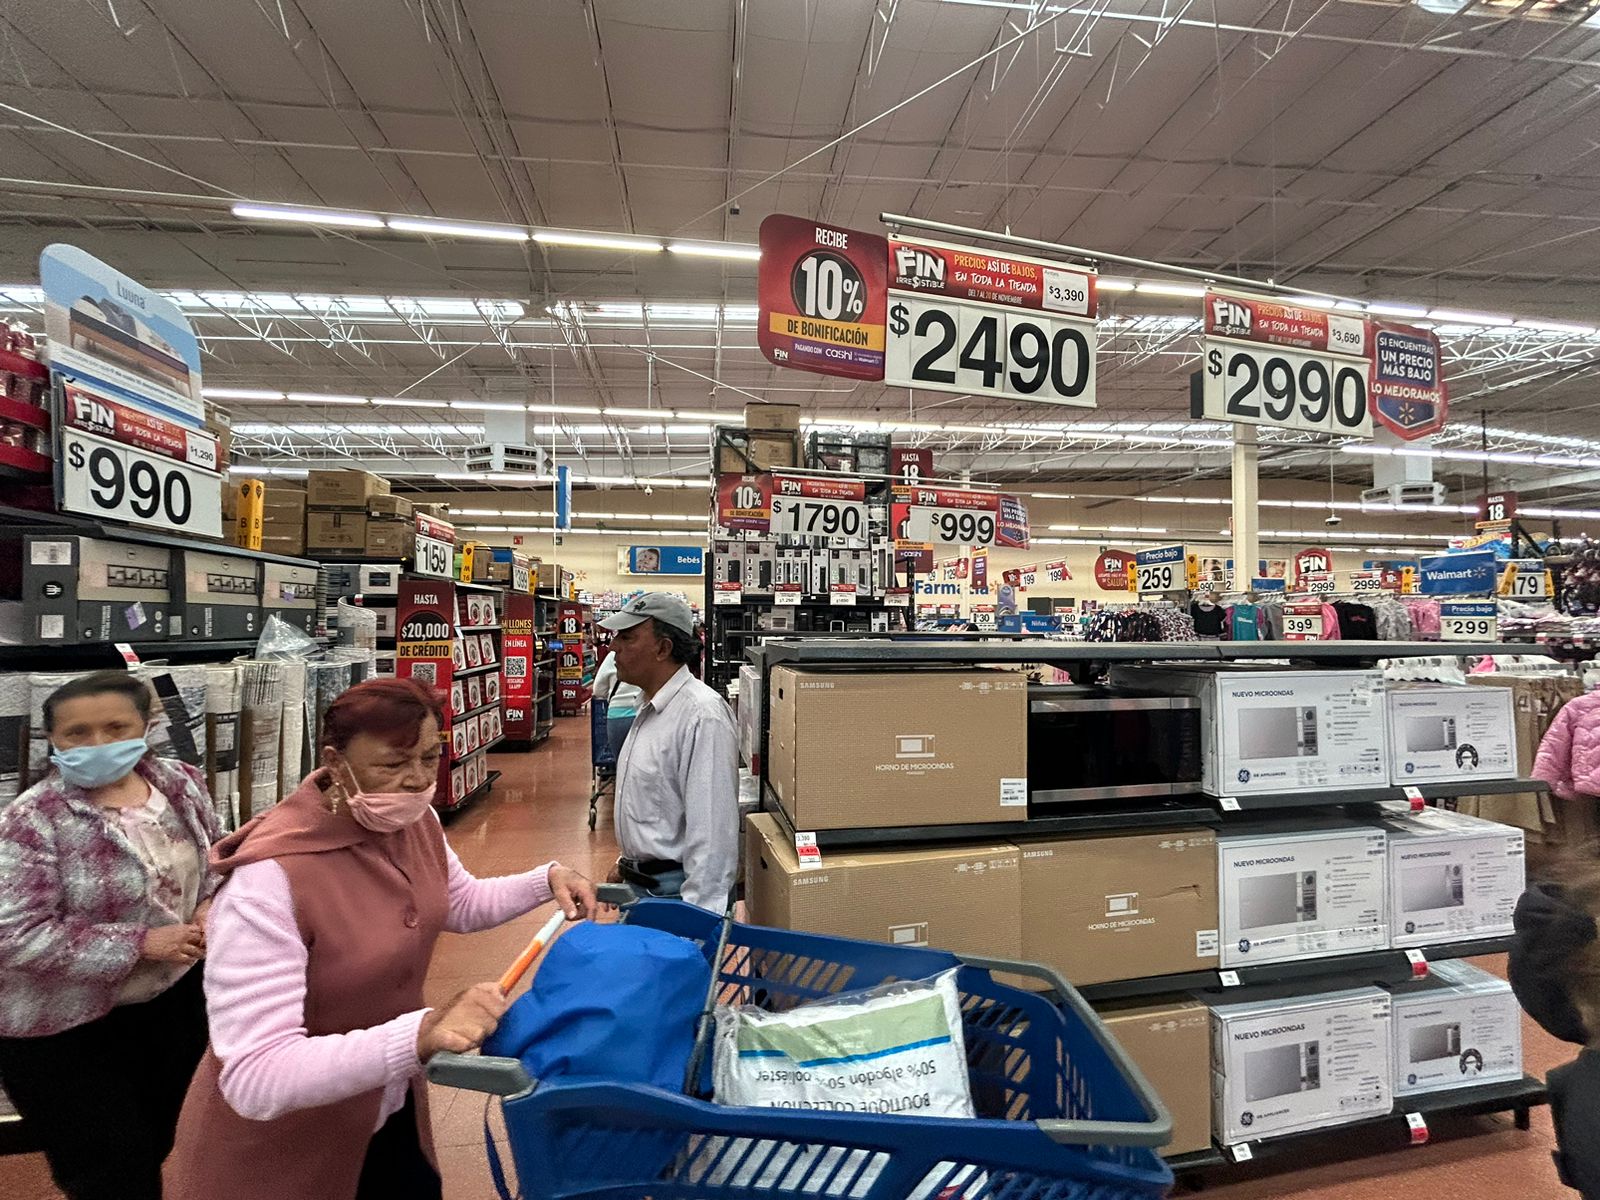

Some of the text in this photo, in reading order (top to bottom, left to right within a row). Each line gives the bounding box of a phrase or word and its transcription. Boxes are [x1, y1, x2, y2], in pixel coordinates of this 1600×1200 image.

[816, 227, 848, 250] RECIBE
[895, 250, 945, 281] FIN
[954, 254, 1038, 280] PRECIOS ASÍ DE BAJOS,
[801, 255, 863, 320] 10%
[954, 272, 1037, 293] EN TODA LA TIENDA
[116, 279, 147, 310] Luuna
[1049, 285, 1085, 302] $3,390
[1212, 301, 1251, 329] FIN
[787, 319, 868, 346] DE BONIFICACIÓN
[1258, 320, 1324, 337] EN TODA LA TIENDA
[1332, 329, 1361, 345] $3,690
[774, 348, 788, 359] FIN
[889, 302, 1090, 398] $2490
[1379, 337, 1434, 355] SI ENCUENTRAS
[1381, 350, 1433, 370] UN PRECIO
[1382, 362, 1432, 382] MÁS BAJO
[1208, 348, 1367, 428] $2990
[1371, 382, 1440, 404] LO MEJORAMOS
[73, 395, 116, 429] FIN
[901, 453, 920, 462] HASTA
[68, 441, 192, 526] $990
[902, 464, 919, 486] 18
[780, 479, 802, 492] FIN
[735, 486, 762, 510] 10%
[918, 492, 937, 502] FIN
[772, 500, 860, 536] $1790
[1488, 504, 1504, 520] 18
[931, 512, 995, 544] $999
[416, 540, 446, 574] $159
[677, 556, 700, 564] Bebés
[1145, 549, 1178, 560] Precio bajo
[1104, 558, 1122, 569] FIN
[1298, 556, 1326, 574] FIN
[1137, 566, 1172, 590] $259
[1426, 570, 1472, 580] Walmart
[414, 594, 438, 605] HASTA
[1476, 606, 1492, 614] bajo
[401, 622, 450, 640] $20,000
[564, 618, 576, 634] 18
[1288, 618, 1312, 632] 399
[1446, 620, 1489, 634] $299
[400, 642, 450, 656] DE CRÉDITO
[504, 638, 527, 648] EN LÍNEA
[562, 654, 578, 667] 10%
[800, 682, 835, 690] SAMSUNG
[506, 709, 524, 719] FIN
[875, 763, 900, 772] HORNO
[910, 762, 954, 770] MICROONDAS
[1023, 849, 1054, 859] SAMSUNG
[1234, 856, 1295, 868] NUEVO MICROONDAS
[792, 876, 829, 886] SAMSUNG
[1088, 922, 1110, 931] HORNO
[1118, 917, 1156, 927] MICROONDAS
[1234, 1023, 1306, 1041] NUEVO MICROONDAS
[850, 1067, 903, 1085] algodón
[907, 1060, 936, 1076] 50%
[756, 1070, 812, 1085] poliéster
[860, 1092, 930, 1115] BOUTIQUE
